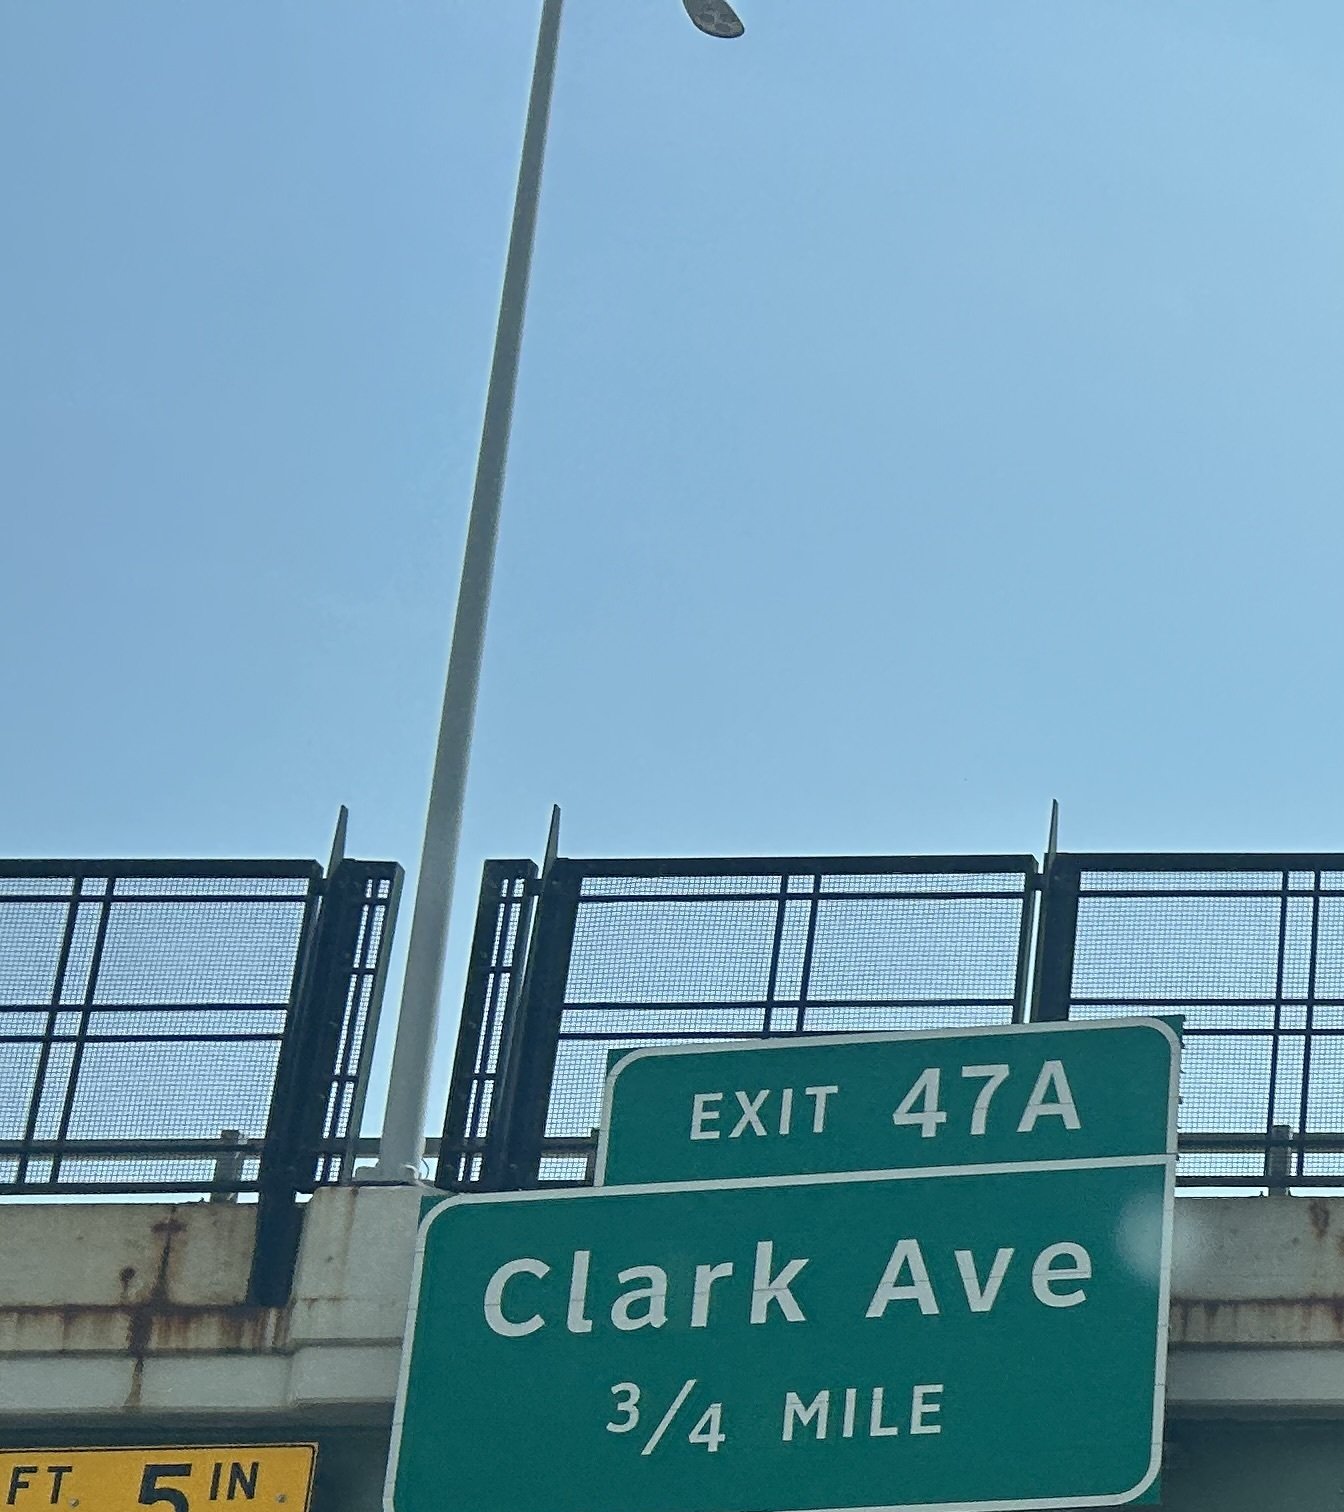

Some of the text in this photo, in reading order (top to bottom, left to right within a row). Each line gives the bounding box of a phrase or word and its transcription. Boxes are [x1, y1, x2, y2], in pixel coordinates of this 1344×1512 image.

[689, 1059, 1082, 1141] EXIT 47A
[483, 1238, 1092, 1337] Clark Ave
[606, 1378, 945, 1457] 3/4 MILE
[6, 1465, 73, 1506] FT
[208, 1461, 260, 1501] IN
